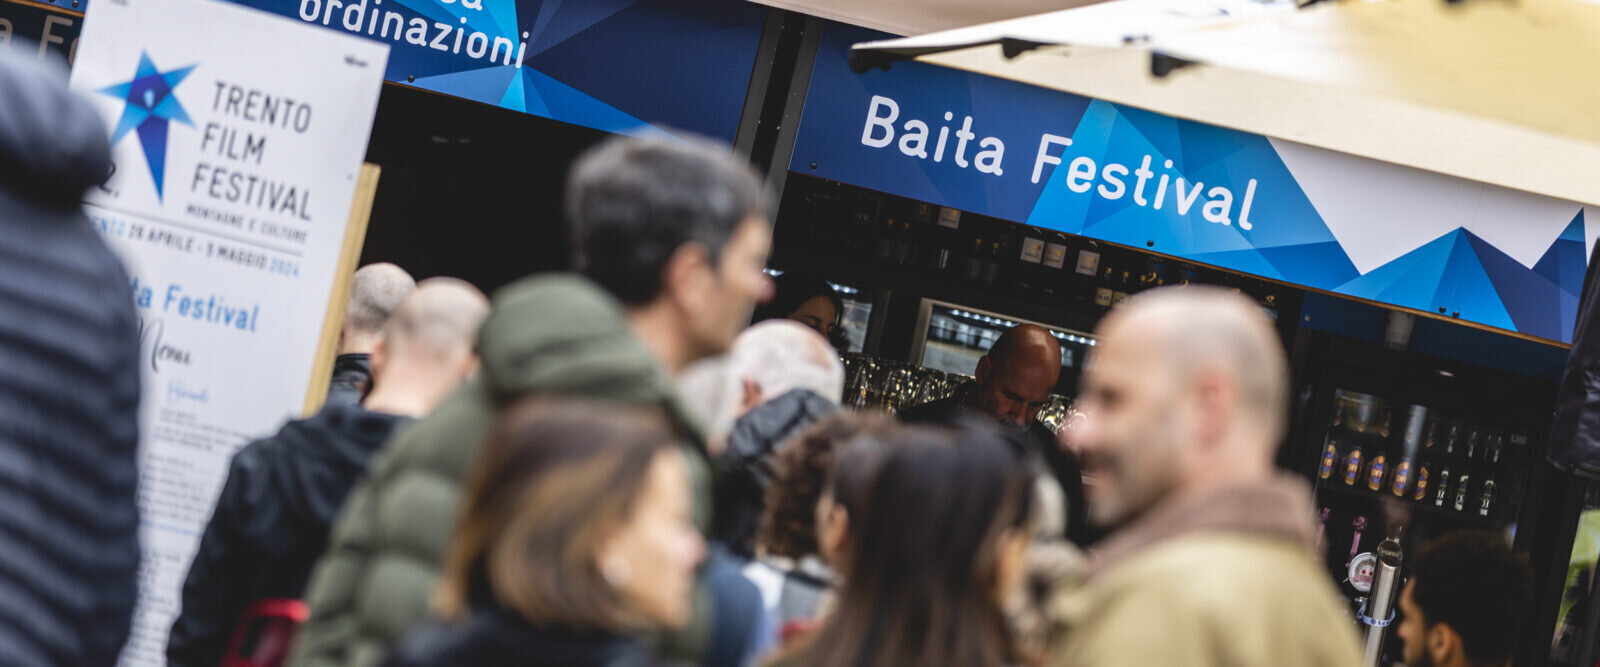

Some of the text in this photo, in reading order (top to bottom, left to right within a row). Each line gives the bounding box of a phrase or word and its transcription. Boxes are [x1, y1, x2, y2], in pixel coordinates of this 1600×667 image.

[299, 0, 529, 69] ordinazioni
[211, 80, 312, 134] TRENTO
[201, 123, 266, 165] FILM
[861, 95, 1257, 231] Baita Festival
[191, 163, 312, 221] FESTIVAL
[91, 215, 126, 237] ENTO
[163, 282, 260, 333] Festival
